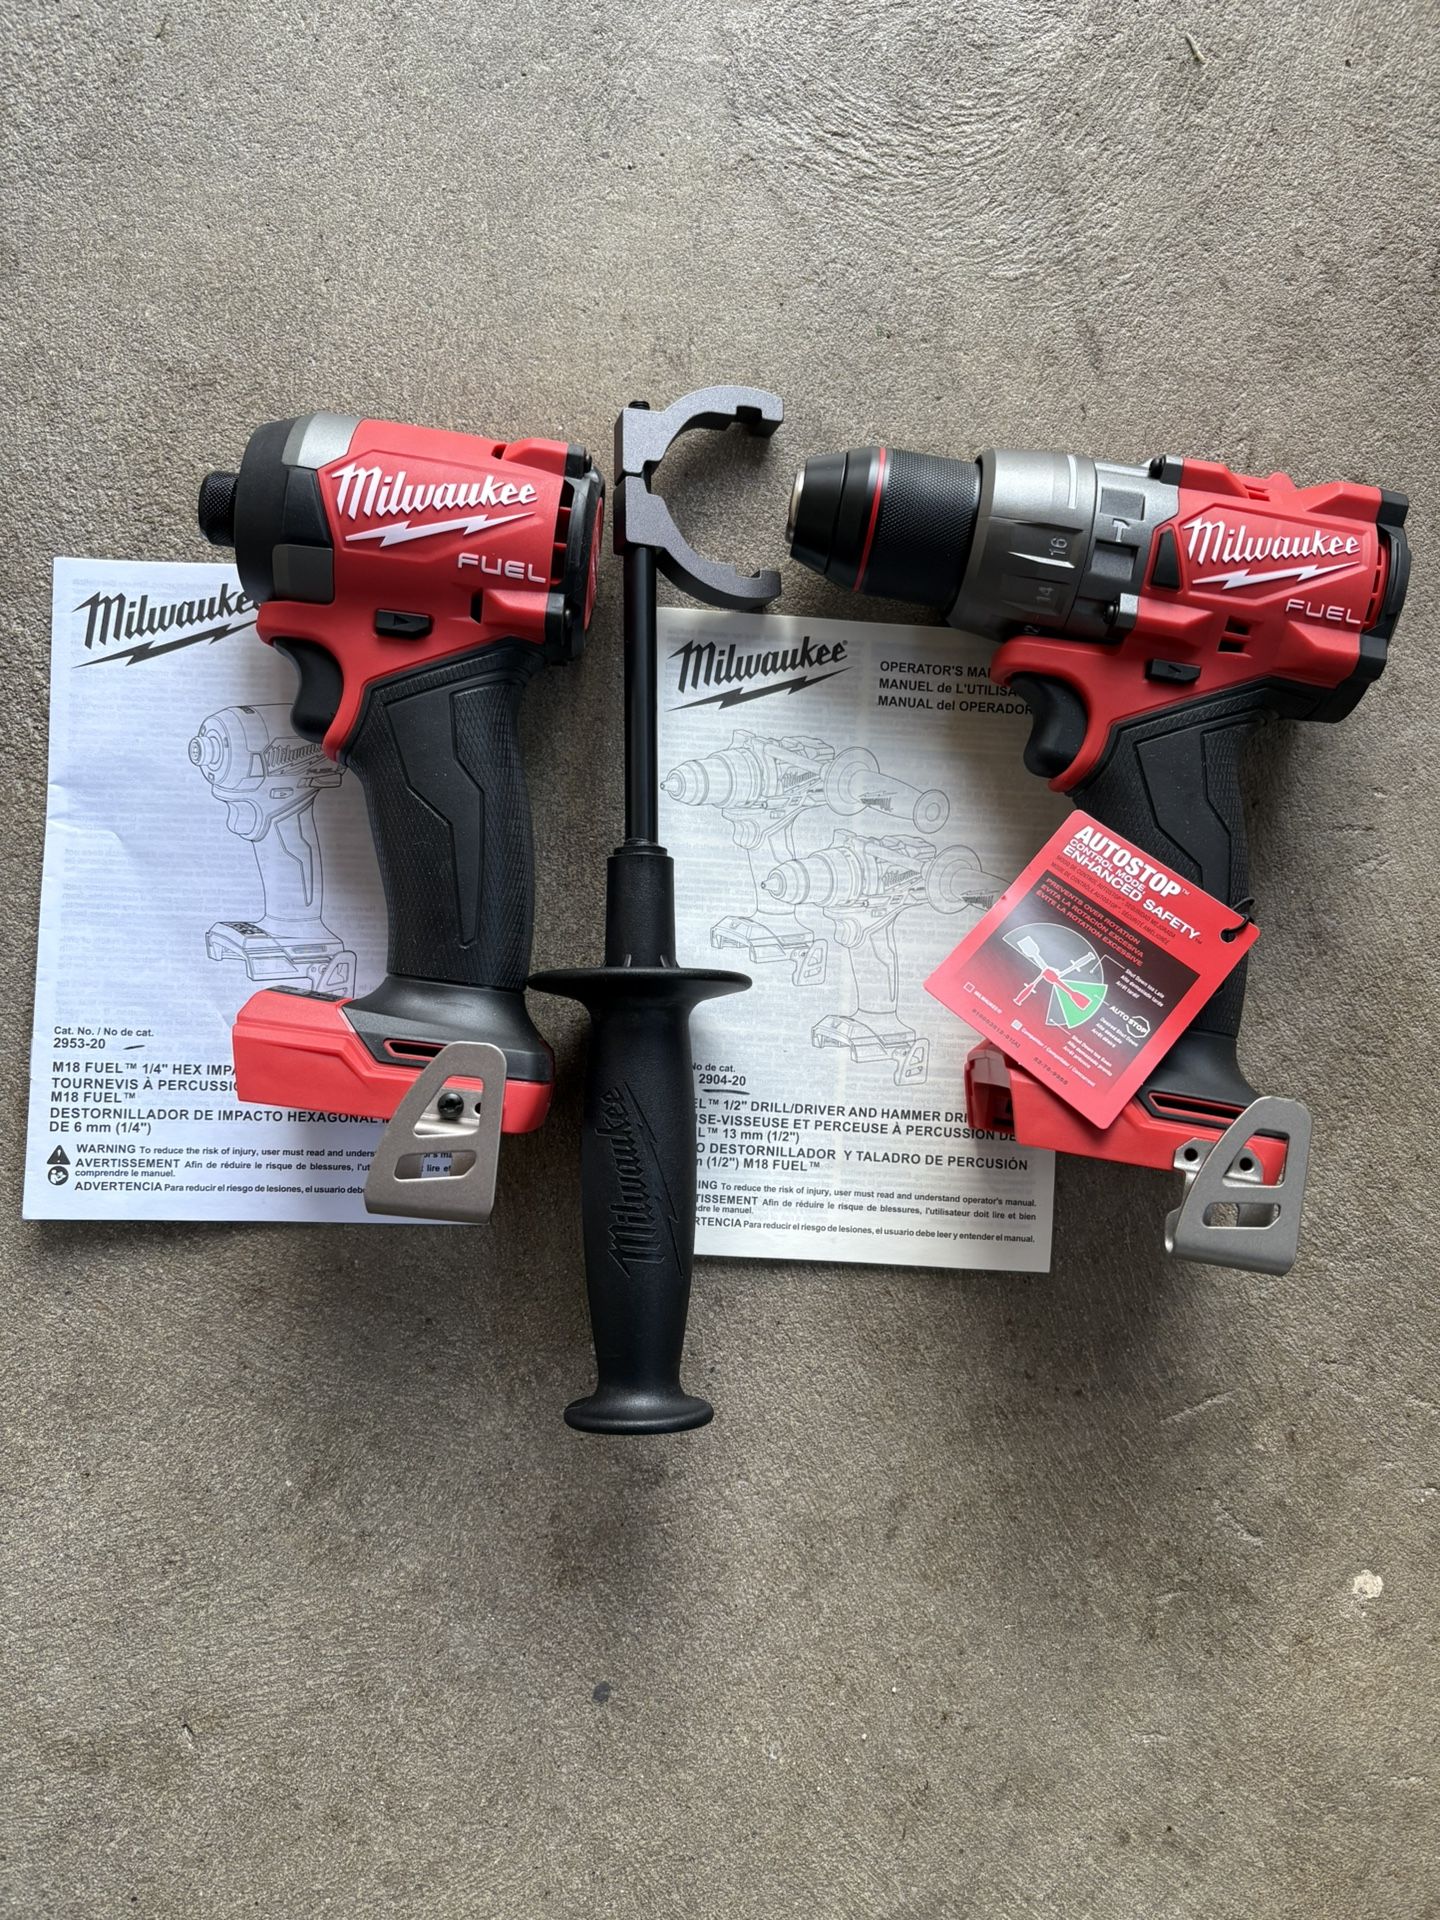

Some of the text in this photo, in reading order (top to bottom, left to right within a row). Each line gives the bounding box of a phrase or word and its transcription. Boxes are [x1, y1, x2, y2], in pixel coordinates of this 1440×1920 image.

[331, 462, 538, 520] Milwaukee
[1050, 537, 1068, 556] 16
[1183, 517, 1361, 565] Milwaukee
[457, 552, 546, 584] FUEL
[72, 582, 260, 650] Milwauke
[1285, 599, 1361, 625] FUEL
[880, 662, 963, 676] OPERATOR'S
[879, 678, 934, 692] MANUEL
[937, 682, 952, 693] de
[877, 695, 933, 709] MANUAL
[936, 700, 955, 711] del
[1068, 837, 1115, 872] CONTROL
[1062, 843, 1143, 903] ENHANCED
[103, 1027, 118, 1036] No
[120, 1028, 133, 1036] de
[53, 1037, 106, 1049] 2953-20
[52, 1061, 80, 1073] M18
[172, 1064, 202, 1075] HEX
[206, 1064, 236, 1076] IMP
[704, 1063, 717, 1072] de
[51, 1077, 139, 1090] TOURNEVIS
[142, 1078, 153, 1090] À
[698, 1073, 746, 1086] 2904-20
[51, 1091, 79, 1102] M18
[50, 1107, 189, 1120] DESTORNILLADOR
[194, 1109, 213, 1121] DE
[218, 1110, 283, 1121] IMPACTO
[750, 1101, 845, 1116] DRILL/DRIVER
[848, 1107, 877, 1118] AND
[881, 1109, 941, 1122] HAMMER
[944, 1112, 969, 1123] DRI
[49, 1121, 70, 1132] DE
[74, 1121, 82, 1133] 6
[86, 1124, 111, 1133] mm
[723, 1128, 737, 1139] 13
[740, 1131, 763, 1140] mm
[793, 1119, 810, 1130] ET
[814, 1120, 888, 1134] PERCEUSE
[892, 1122, 902, 1135] À
[906, 1125, 995, 1140] PERCUSSION
[76, 1144, 136, 1154] WARNING
[139, 1146, 151, 1154] To
[202, 1147, 218, 1155] risk
[221, 1147, 230, 1155] of
[306, 1149, 325, 1157] read
[327, 1149, 344, 1157] and
[710, 1143, 1028, 1170] DESTORNILLADOR Y TALADRO DE PERCUSIÓN
[75, 1158, 180, 1168] AVERTISSEMENT
[206, 1161, 217, 1169] de
[220, 1161, 252, 1169] réduire
[265, 1162, 293, 1171] risque
[295, 1162, 307, 1170] de
[743, 1158, 769, 1169] M18
[131, 1169, 139, 1177] le
[74, 1181, 163, 1191] ADVERTENCIA
[164, 1183, 184, 1191] Para
[185, 1184, 217, 1192] reducir
[226, 1185, 254, 1193] riesgo
[595, 1086, 666, 1278] Milwaukee
[721, 1182, 732, 1191] To
[733, 1184, 762, 1192] reduce
[763, 1185, 777, 1193] the
[796, 1186, 805, 1194] of
[914, 1194, 961, 1203] understand
[962, 1197, 1003, 1205] operator's
[762, 1198, 779, 1206] Afin
[795, 1200, 824, 1209] réduire
[838, 1203, 864, 1212] risque
[866, 1204, 877, 1212] de
[925, 1207, 971, 1217] l'utilisateur
[973, 1210, 990, 1218] doit
[992, 1211, 1005, 1219] lire
[1007, 1212, 1016, 1220] et
[1018, 1212, 1036, 1220] bien
[743, 1220, 762, 1228] Para
[763, 1222, 792, 1230] reducir
[801, 1224, 826, 1233] riesgo
[827, 1224, 837, 1232] de
[915, 1229, 936, 1238] debe
[936, 1230, 952, 1239] leer
[959, 1233, 995, 1241] entender
